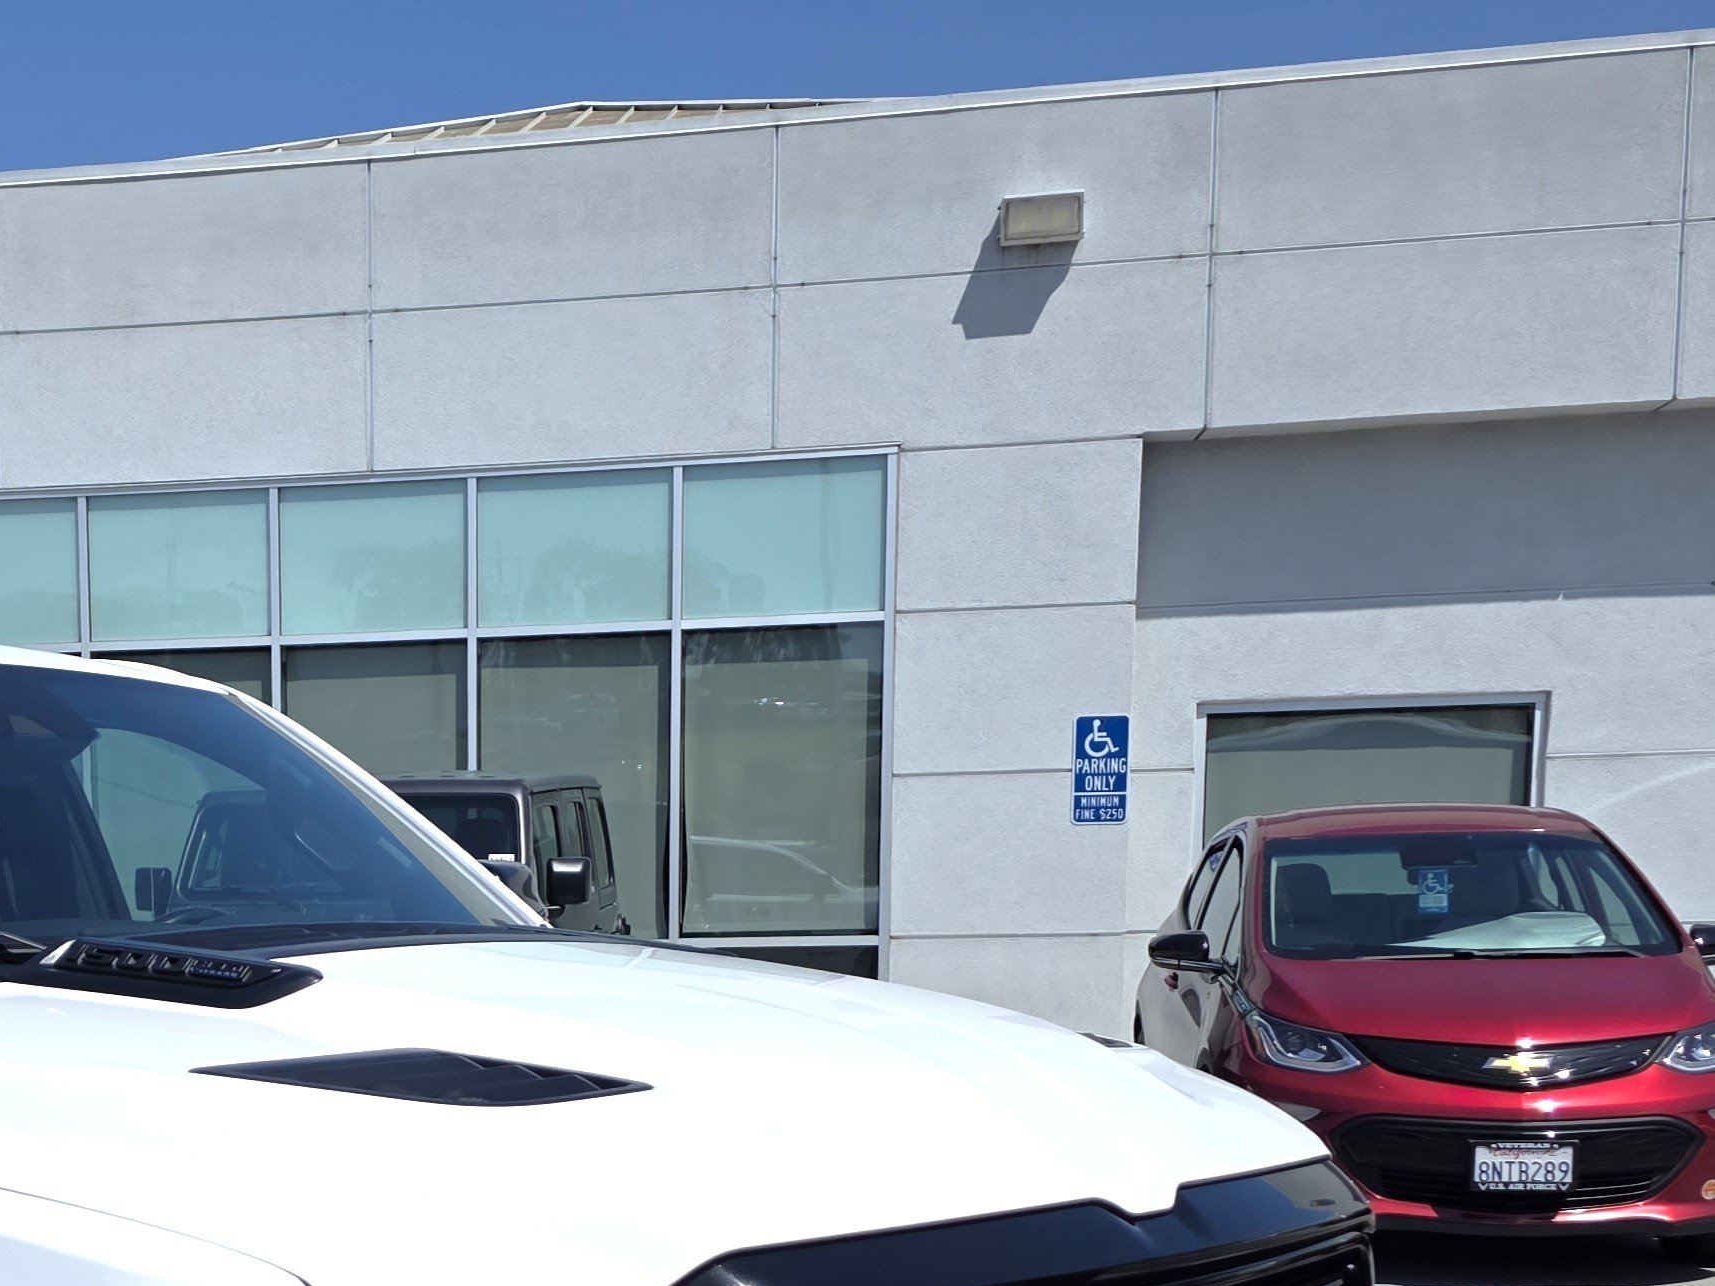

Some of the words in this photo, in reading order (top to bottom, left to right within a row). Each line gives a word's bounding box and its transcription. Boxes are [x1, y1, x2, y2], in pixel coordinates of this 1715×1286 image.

[1076, 758, 1126, 774] PARKING
[1085, 776, 1116, 791] ONLY
[1081, 796, 1119, 807] MINIMUM
[1075, 809, 1095, 820] FINE
[1100, 808, 1124, 820] $250
[1479, 1161, 1570, 1181] 8NTB289
